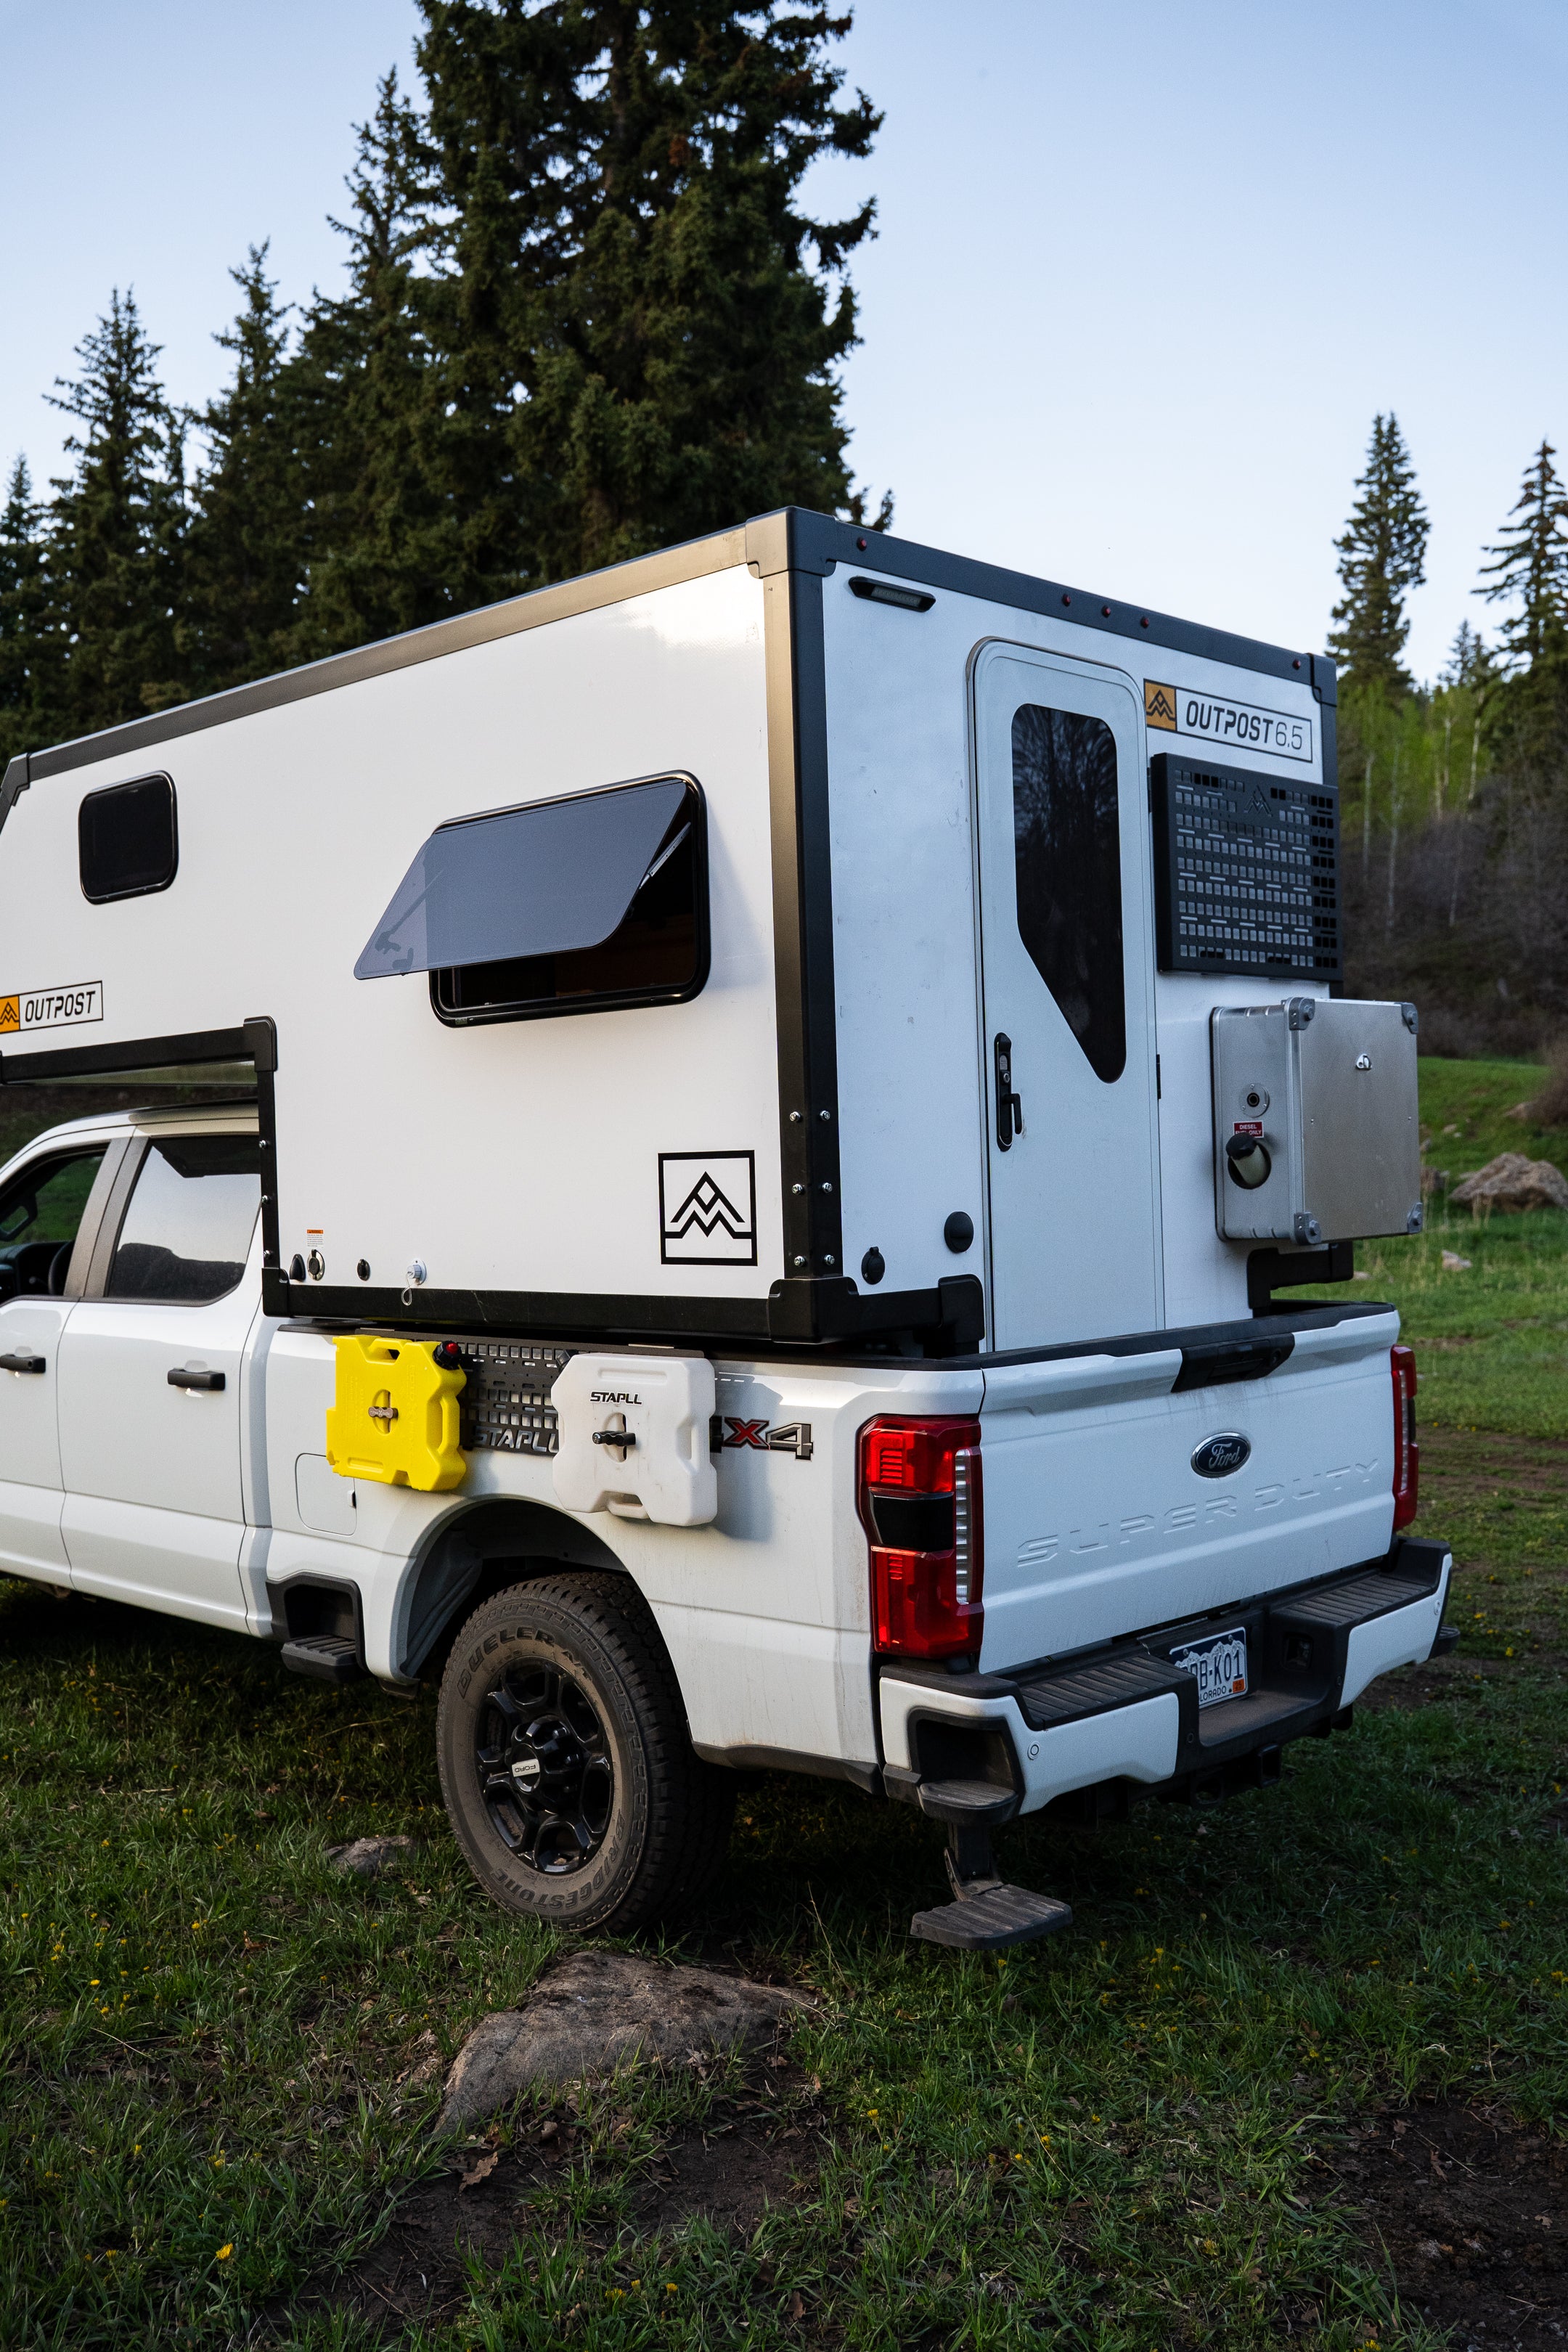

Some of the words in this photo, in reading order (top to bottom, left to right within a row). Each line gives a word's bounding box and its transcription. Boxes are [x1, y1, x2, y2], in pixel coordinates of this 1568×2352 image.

[1185, 701, 1273, 744] OUTPOST
[1275, 721, 1303, 751] 6.5
[25, 990, 96, 1023] OUTPOST
[589, 1391, 643, 1406] STAPLL
[709, 1416, 814, 1461] X4
[1208, 1442, 1241, 1469] Ford
[1017, 1495, 1238, 1568] SUPER
[1254, 1458, 1379, 1512] DUTY
[457, 1626, 555, 1699] DUELER
[1181, 1649, 1243, 1690] B-K01
[1200, 1686, 1227, 1702] LORADO
[514, 1764, 536, 1773] FORD
[491, 1808, 625, 1910] BRIDGESTONE
